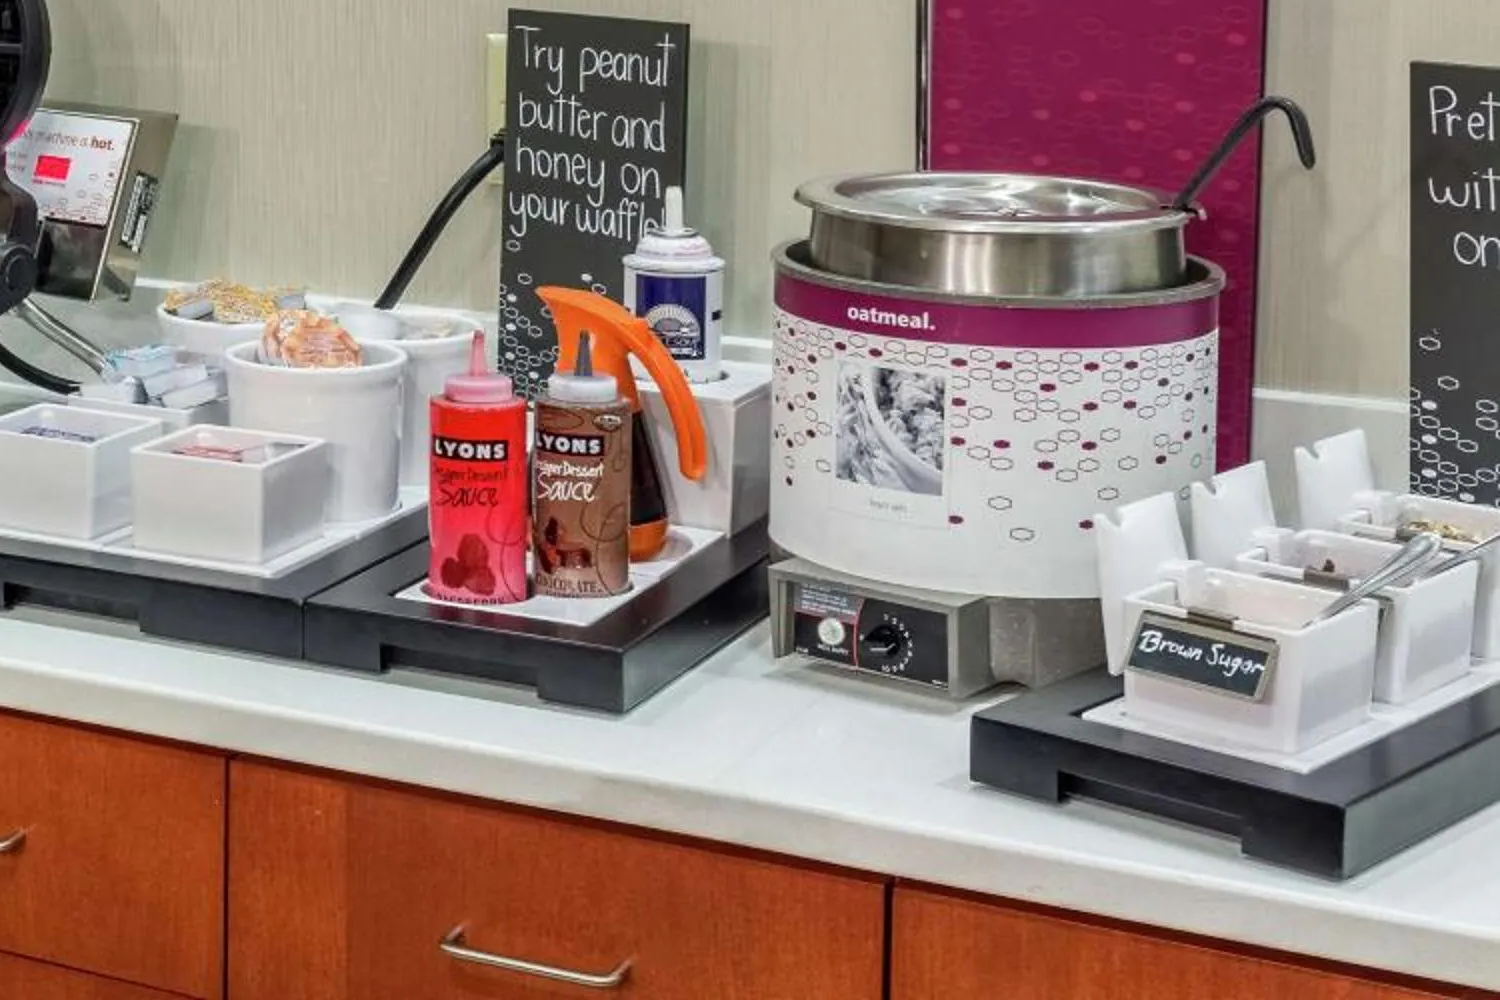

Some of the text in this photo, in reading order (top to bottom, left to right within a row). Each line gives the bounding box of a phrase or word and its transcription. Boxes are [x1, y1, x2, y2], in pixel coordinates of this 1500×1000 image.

[515, 26, 676, 95] Try peanut
[90, 137, 115, 151] hot.
[519, 92, 665, 153] butter and
[516, 137, 660, 208] honey on
[509, 191, 571, 237] your
[847, 307, 936, 331] oatmeal.
[434, 439, 506, 459] LYONS
[536, 433, 601, 454] LYONS
[1138, 630, 1266, 677] Brown Sugar
